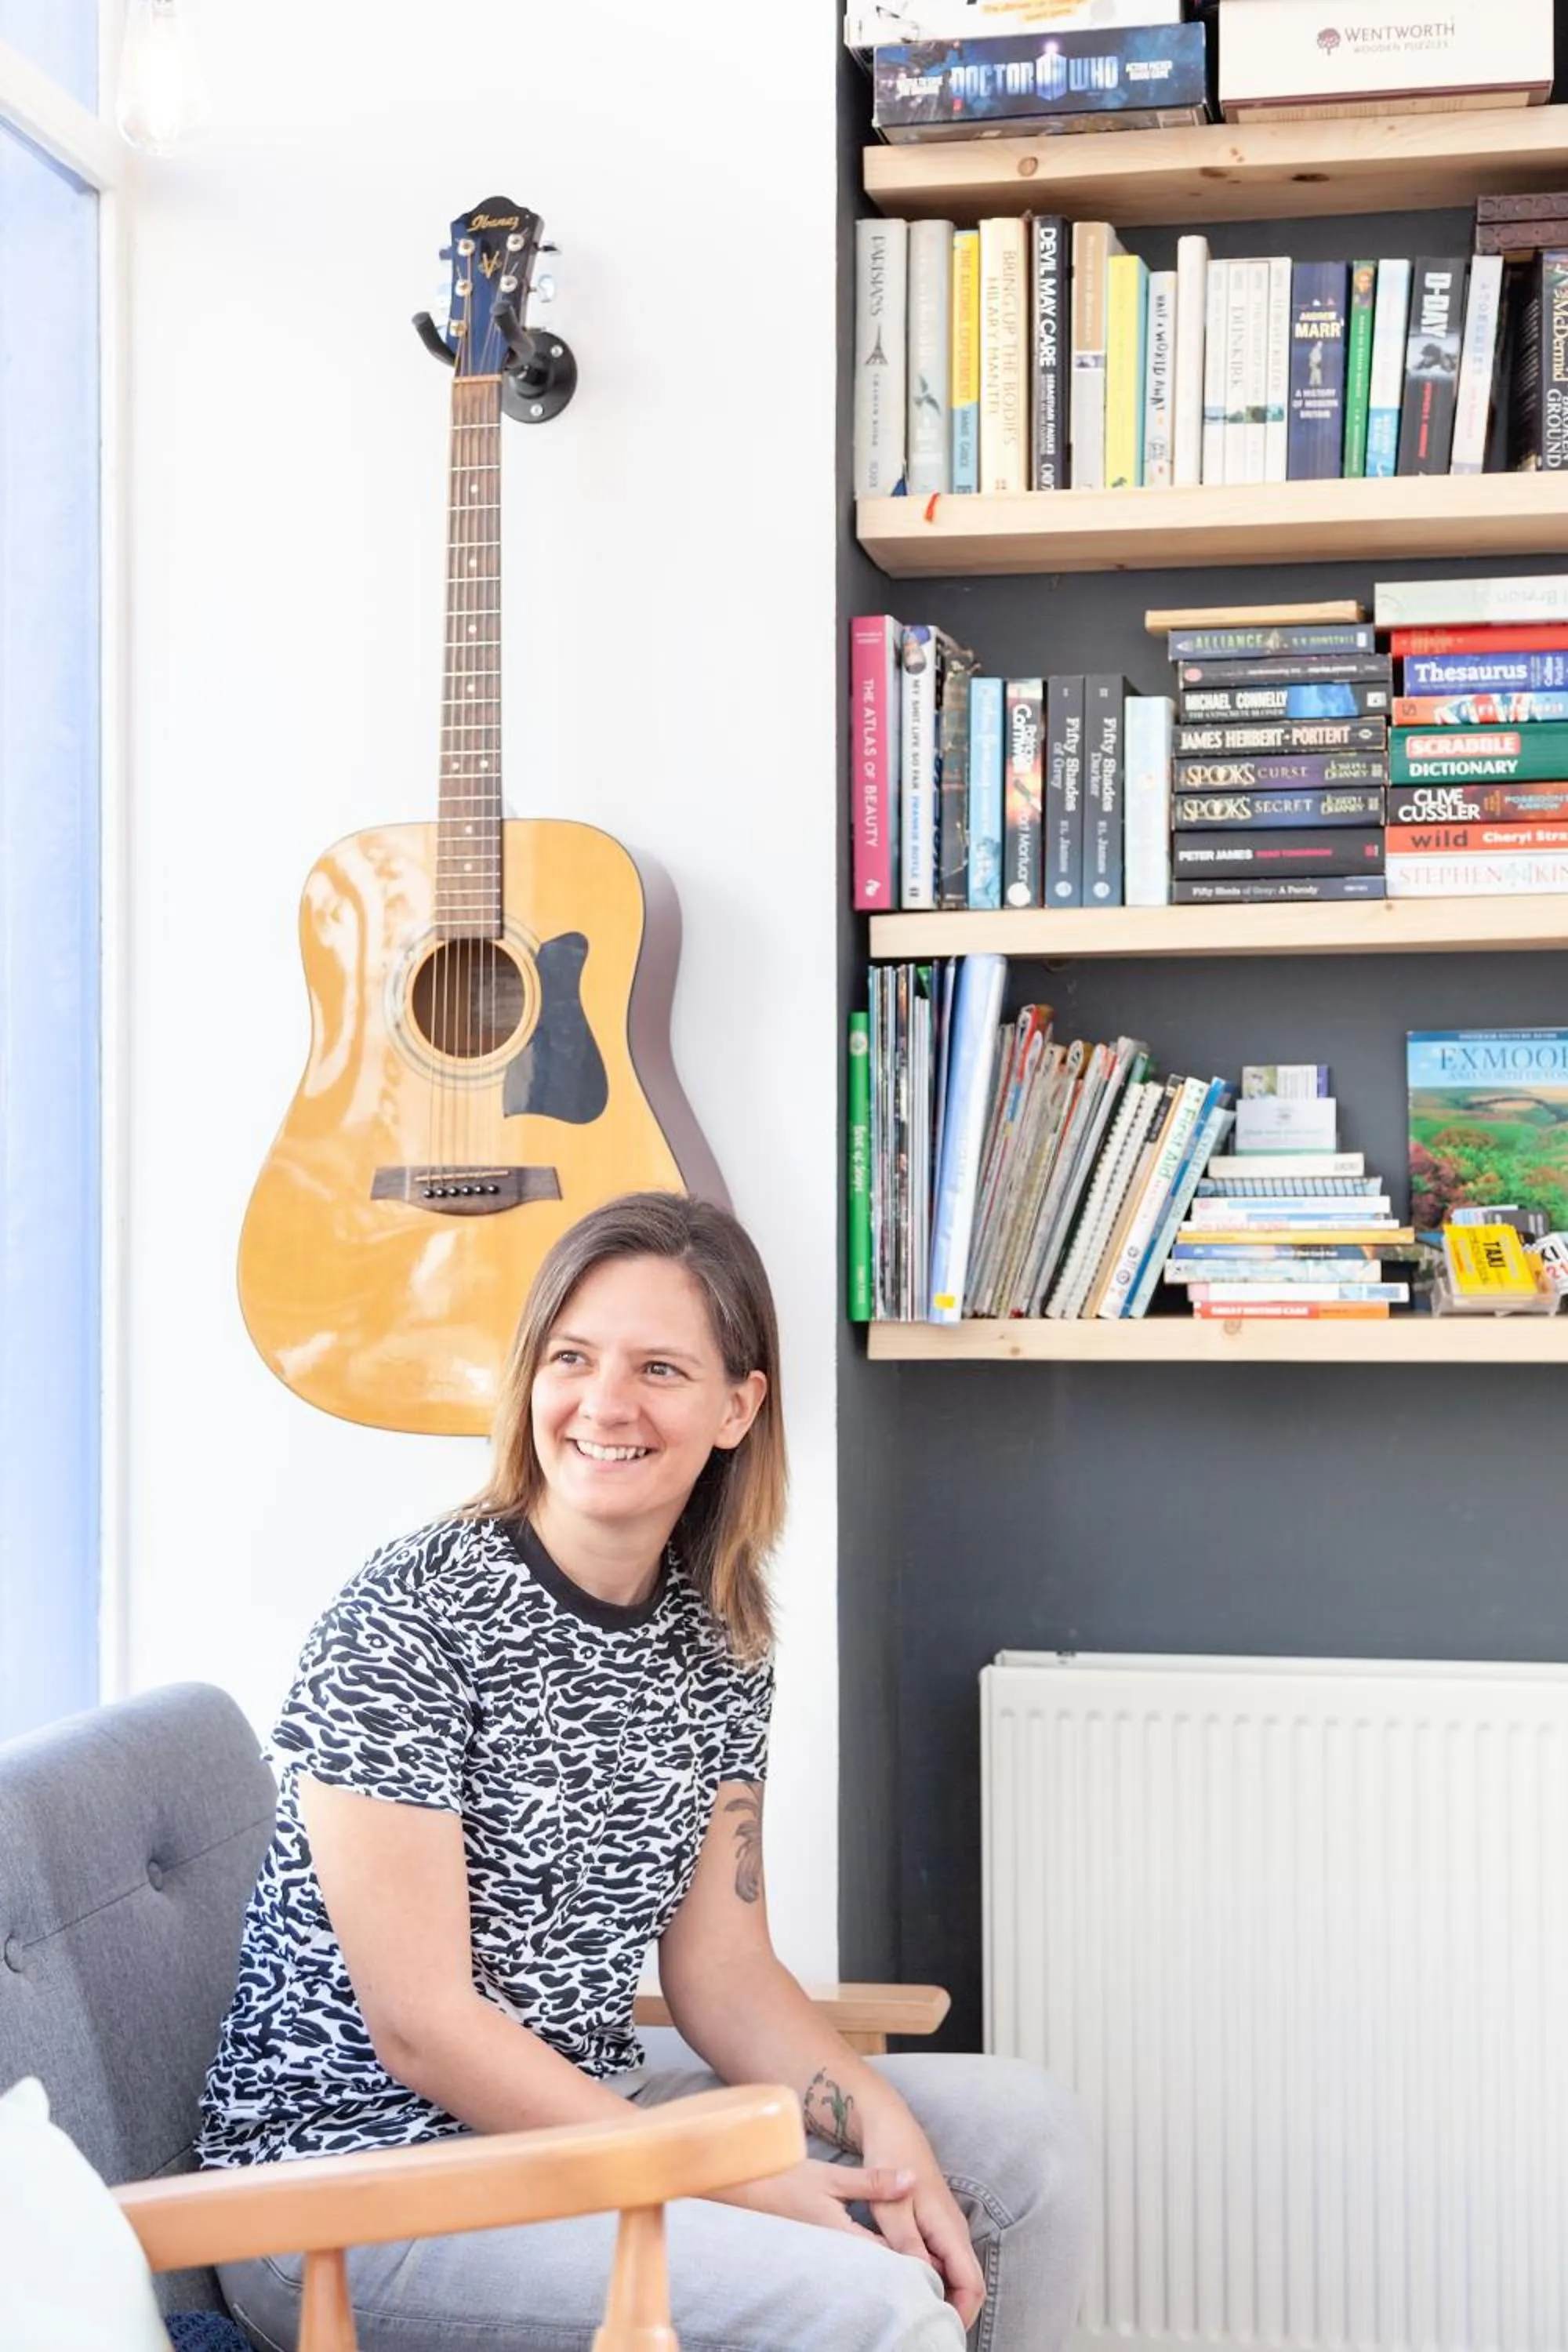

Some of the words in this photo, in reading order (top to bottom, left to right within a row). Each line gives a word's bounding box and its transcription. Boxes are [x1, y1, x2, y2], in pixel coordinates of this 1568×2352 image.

[1345, 23, 1456, 42] WENTWORTH
[1354, 43, 1401, 53] WOODEN
[1404, 39, 1450, 50] PUZZLES
[949, 62, 1035, 97] DOCTOR
[1069, 56, 1120, 91] WHO
[466, 214, 520, 233] Ibanez
[1040, 228, 1056, 274] DEVIL
[869, 236, 887, 317] PARISIANS
[1003, 250, 1017, 307] BRING
[986, 278, 999, 339] HILARY
[1040, 278, 1056, 319] MAY
[1420, 272, 1452, 338] D-DAY
[1003, 312, 1017, 336] UP
[1294, 322, 1341, 338] MARR
[1040, 319, 1056, 367] CARE
[1230, 306, 1244, 390] DUNKIRK
[1552, 299, 1568, 382] McDermid
[958, 328, 971, 399] EXPERIMENT
[1003, 343, 1018, 374] THE
[986, 347, 999, 416] MANTEL
[1003, 382, 1018, 446] BODIES
[1547, 389, 1562, 467] GROUND
[1195, 633, 1264, 649] ALLIANCE
[911, 680, 920, 695] MY
[1414, 662, 1528, 682] Thesaurus
[863, 679, 875, 703] THE
[1185, 692, 1231, 711] MICHAEL
[1236, 690, 1288, 709] CONNELLY
[911, 700, 920, 724] SHIT
[862, 707, 877, 756] ATLAS
[911, 726, 920, 748] LIFE
[1013, 705, 1032, 774] Cornwell
[1064, 717, 1080, 754] Fifty
[1101, 717, 1116, 754] Fifty
[1181, 730, 1222, 750] JAMES
[1225, 728, 1284, 749] HERBERT
[1292, 725, 1352, 746] PORTENT
[1413, 736, 1515, 754] SCRABBLE
[911, 752, 920, 766] SO
[1054, 742, 1064, 757] of
[864, 761, 876, 781] OF
[911, 770, 920, 789] FAR
[1051, 758, 1063, 789] Grey
[1091, 752, 1102, 797] Darker
[1258, 766, 1309, 779] CURSE
[1409, 760, 1519, 777] DICTIONARY
[1065, 758, 1080, 811] Shades
[1102, 758, 1116, 811] Shades
[1413, 789, 1465, 806] CLIVE
[864, 786, 878, 848] BEAUTY
[1254, 798, 1313, 813] SECRET
[1398, 804, 1481, 822] CUSSLER
[1410, 829, 1468, 848] wild
[1482, 829, 1532, 847] Cheryl
[911, 845, 920, 879] BOYLE
[1018, 834, 1030, 884] Mortuar
[1059, 837, 1069, 873] James
[1098, 837, 1108, 873] James
[1178, 850, 1214, 862] PETER
[1216, 849, 1253, 860] JAMES
[1399, 865, 1502, 886] STEPHEN
[1171, 1106, 1196, 1149] First
[1158, 1149, 1179, 1179] Aid
[1483, 1241, 1506, 1268] TAXI
